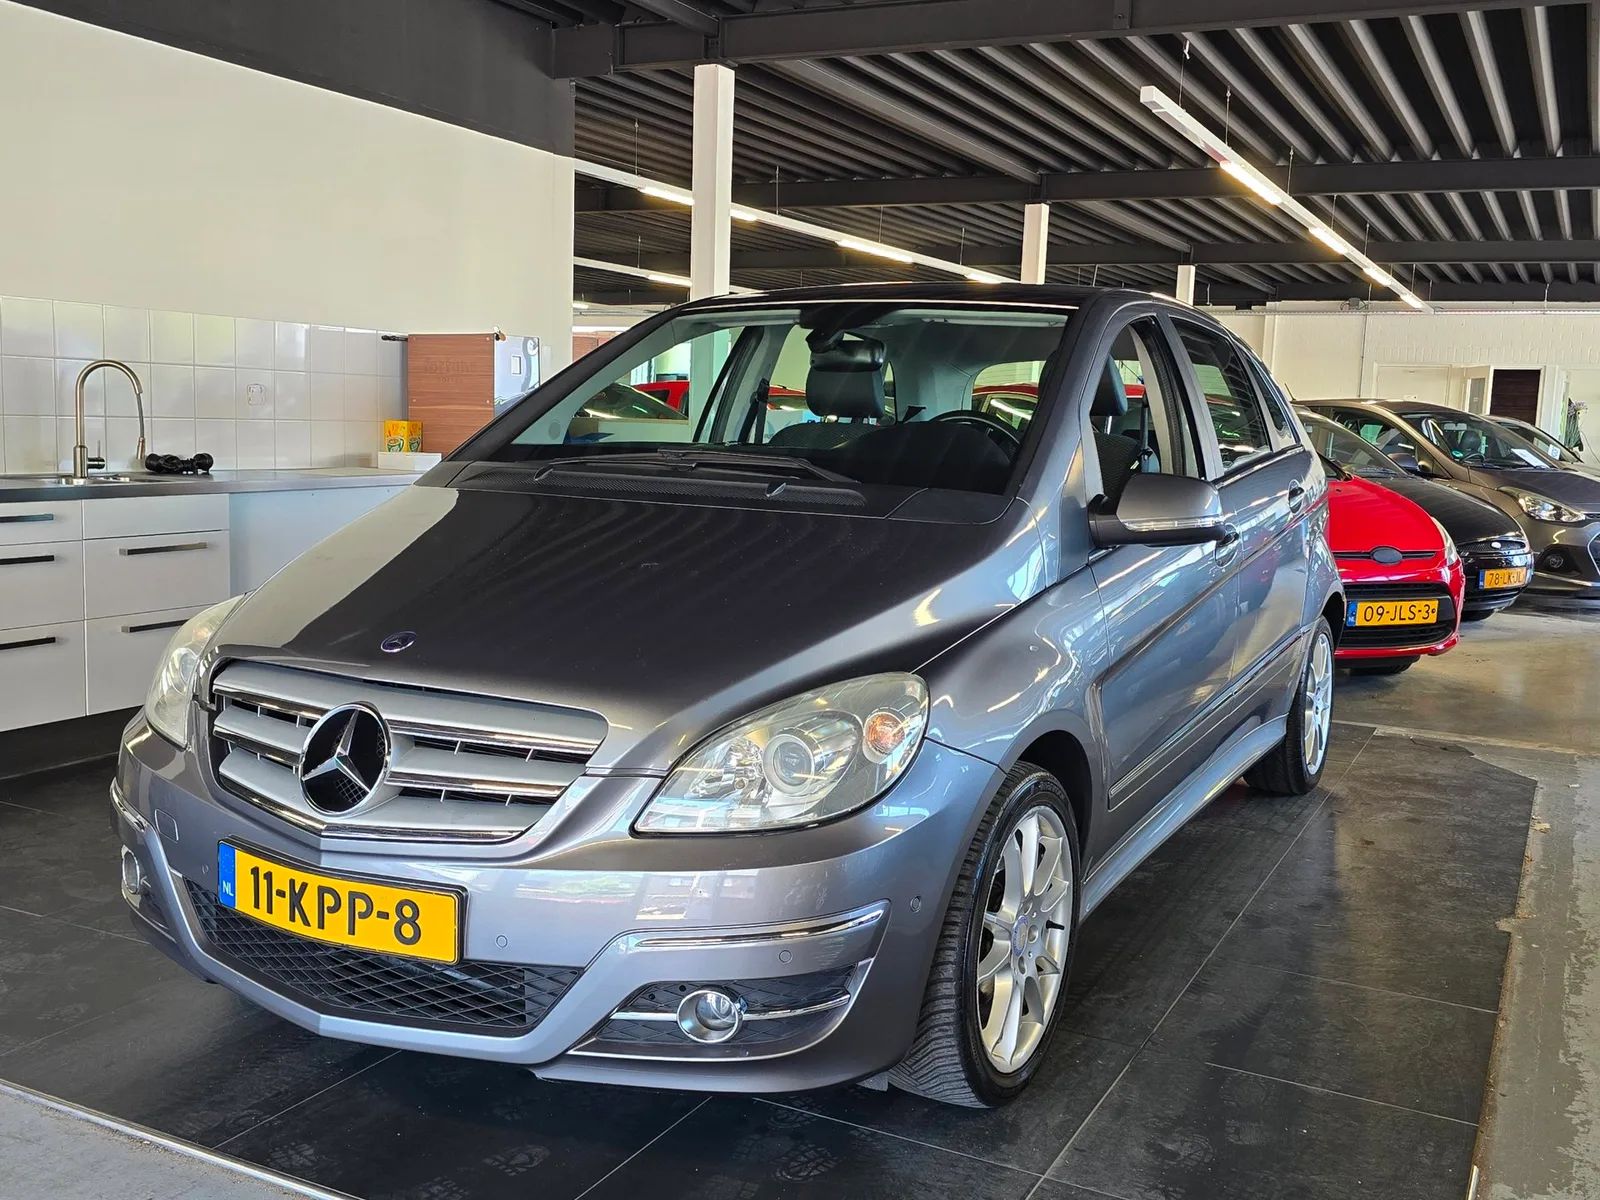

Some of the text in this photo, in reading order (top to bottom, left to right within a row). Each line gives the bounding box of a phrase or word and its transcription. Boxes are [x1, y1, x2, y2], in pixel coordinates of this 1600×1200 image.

[1363, 604, 1431, 622] 09-JLS-3
[222, 880, 234, 897] NL
[250, 866, 422, 946] 11-KPP-8
